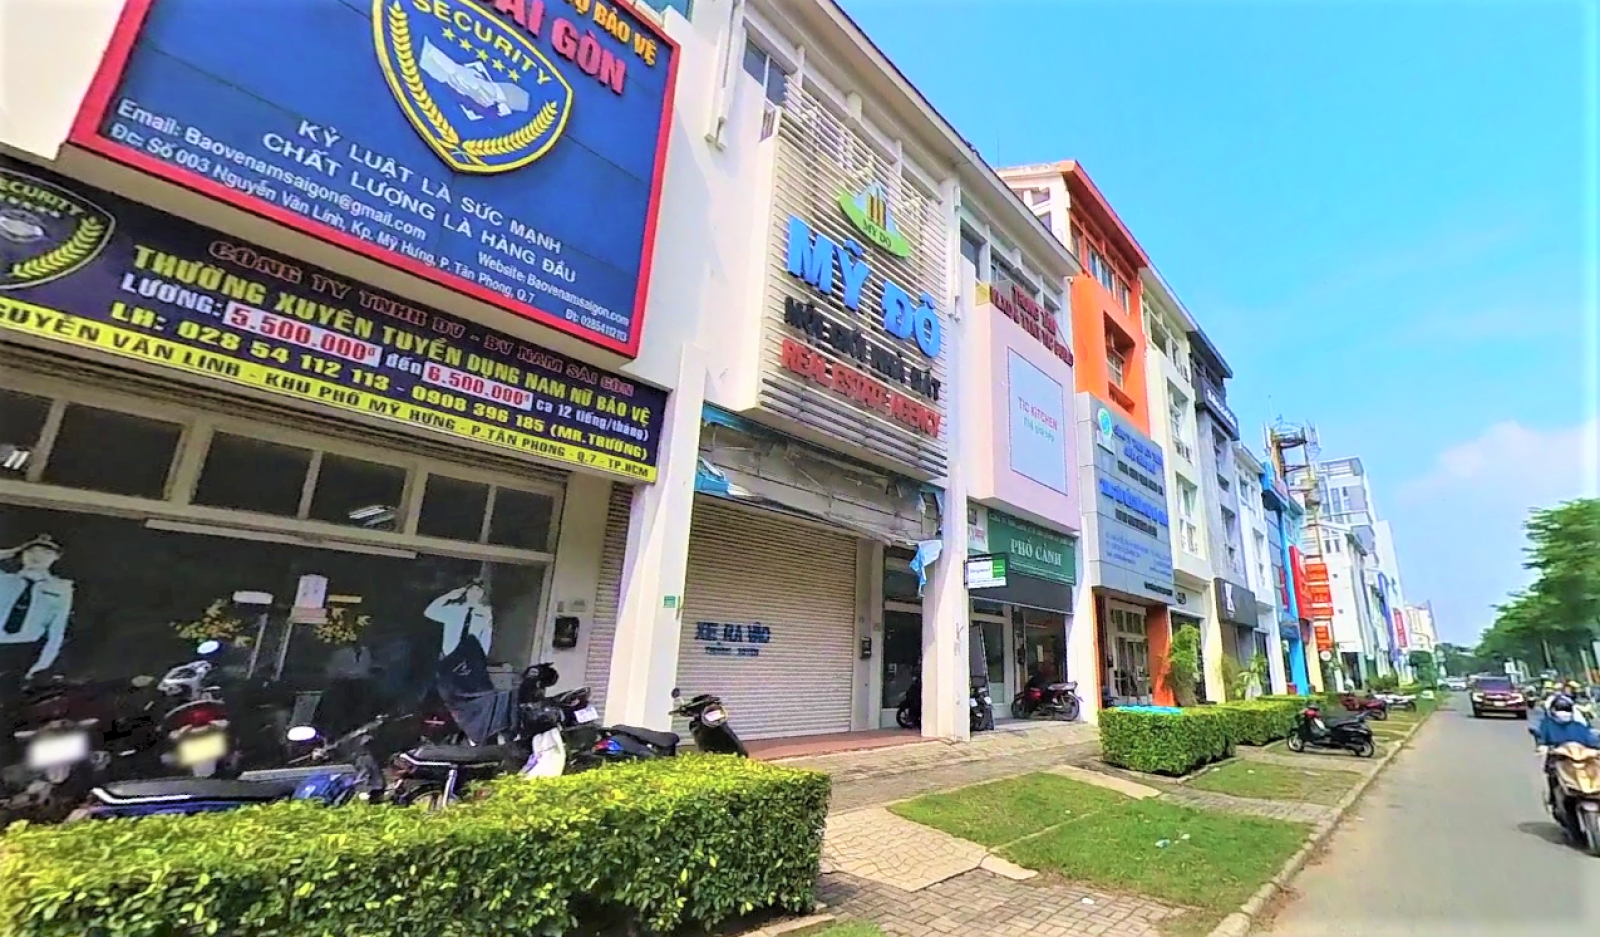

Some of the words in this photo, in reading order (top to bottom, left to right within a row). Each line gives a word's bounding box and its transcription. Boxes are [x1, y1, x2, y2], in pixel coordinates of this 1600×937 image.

[413, 0, 552, 84] SECURITY
[551, 18, 626, 95] GÒN
[593, 3, 630, 43] BẢO
[634, 31, 657, 66] VỆ
[117, 98, 182, 135] Email:
[185, 127, 426, 242] Baovenamsaigon@gmail.com
[147, 137, 173, 159] Số
[175, 149, 210, 173] 003
[212, 164, 276, 203] Nguyễn
[440, 257, 451, 272] P.
[454, 261, 475, 281] Tân
[261, 132, 343, 178] CHẤT
[350, 172, 436, 222] LƯỢNG
[443, 212, 473, 238] LÀ
[481, 230, 537, 265] HÀNG
[349, 143, 414, 183] LUẬT
[422, 177, 451, 203] LÀ
[460, 196, 504, 226] SỨC
[510, 220, 562, 255] MẠNH
[121, 272, 223, 317] LƯƠNG:
[386, 354, 423, 375] đến
[536, 400, 552, 415] ca
[558, 404, 572, 419] 12
[134, 244, 267, 306] THƯỜNG
[274, 291, 374, 340] XUYÊN
[384, 325, 463, 366] TUYỂN
[467, 355, 520, 385] DỤNG
[525, 372, 565, 399] NAM
[571, 386, 594, 408] NỮ
[596, 392, 627, 419] BẢO
[631, 405, 651, 427] VỆ
[312, 273, 351, 300] TY
[517, 347, 563, 374] NAM
[786, 214, 872, 312] MỸ
[881, 280, 941, 359] ĐÔ
[112, 302, 168, 331] LH:
[178, 320, 241, 350] 028
[251, 340, 290, 364] 54
[300, 355, 342, 378] 112
[352, 369, 389, 391] 113
[412, 386, 466, 412] 0908
[473, 402, 508, 423] 396
[515, 414, 545, 432] 185
[183, 352, 241, 377] LINH
[265, 373, 311, 394] KHU
[318, 384, 362, 406] PHỐ
[369, 397, 402, 414] MỸ
[522, 437, 566, 458] PHONG
[577, 451, 597, 466] Q.7
[608, 458, 649, 477] TP.HCM
[782, 337, 833, 388] REAL
[1031, 405, 1058, 430] KITCHEN
